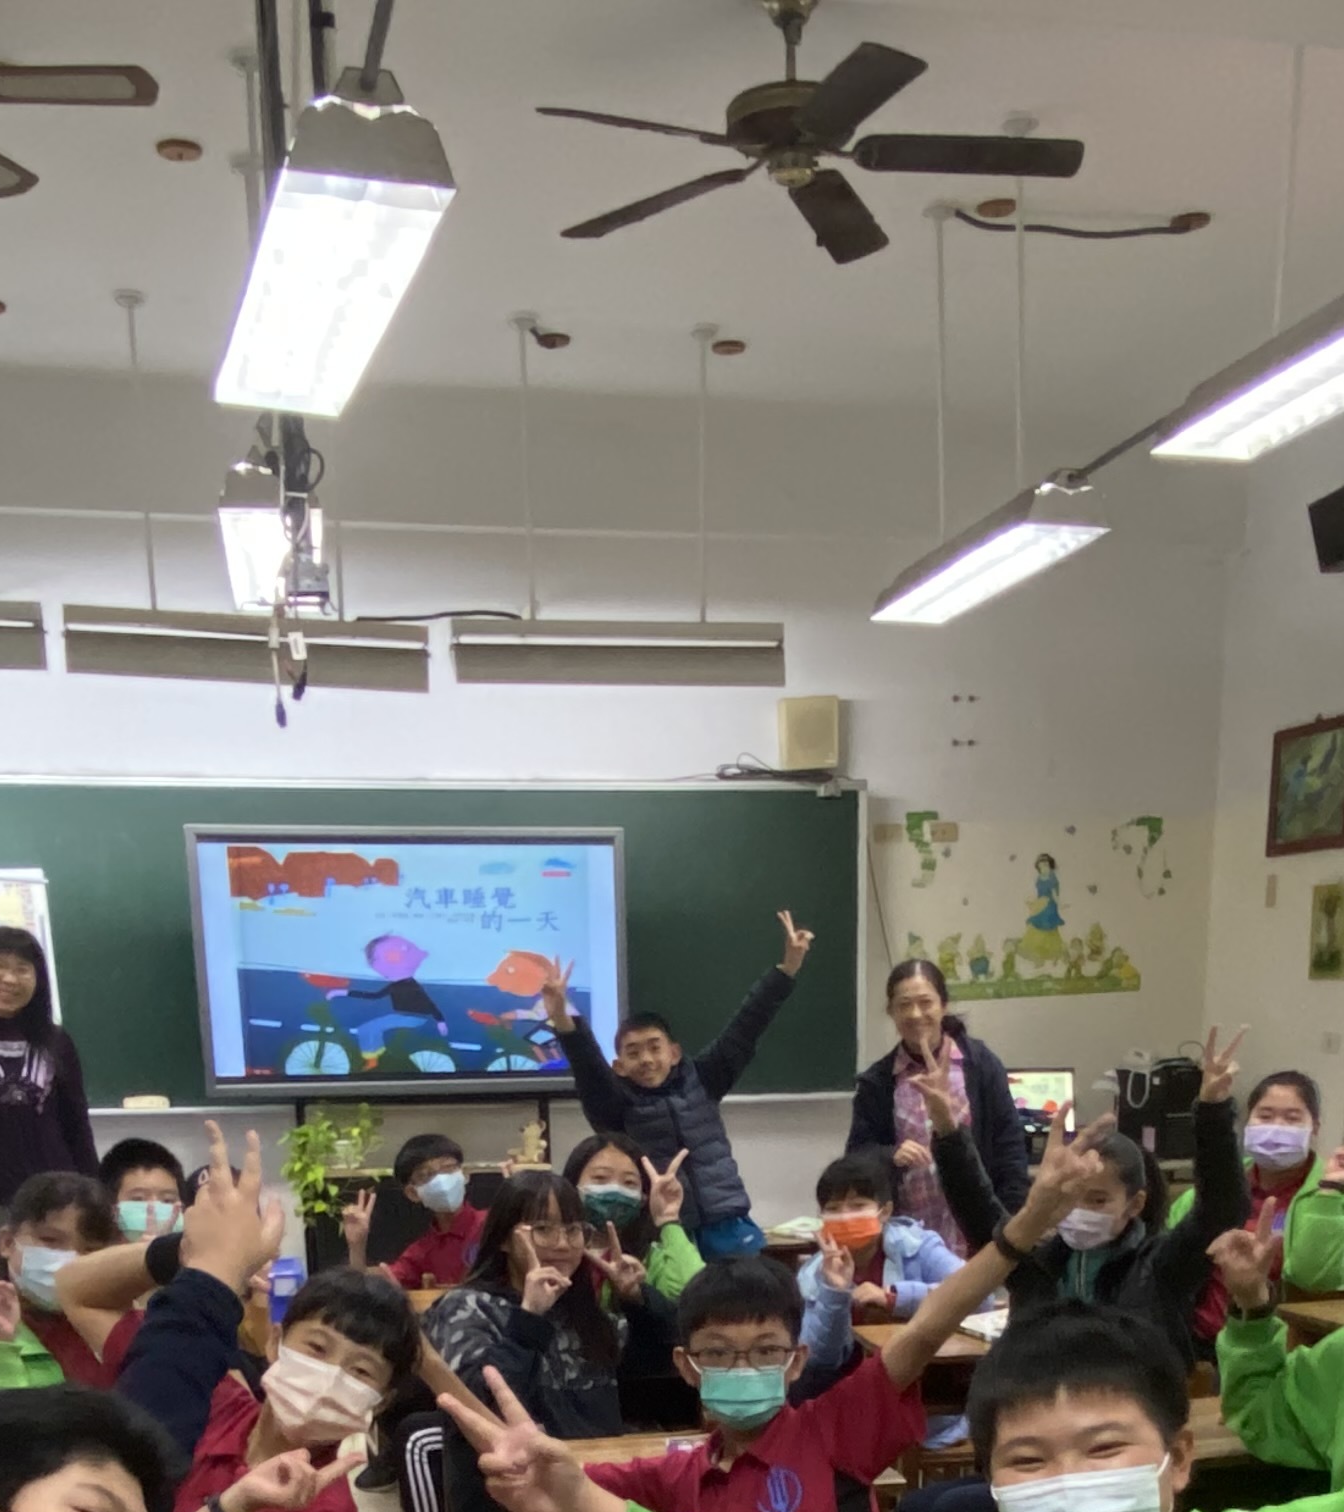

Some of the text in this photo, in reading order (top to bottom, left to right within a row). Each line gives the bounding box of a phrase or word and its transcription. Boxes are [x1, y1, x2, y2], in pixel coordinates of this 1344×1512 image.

[404, 886, 517, 910] 汽車睡覺
[479, 909, 560, 932] 的一天
